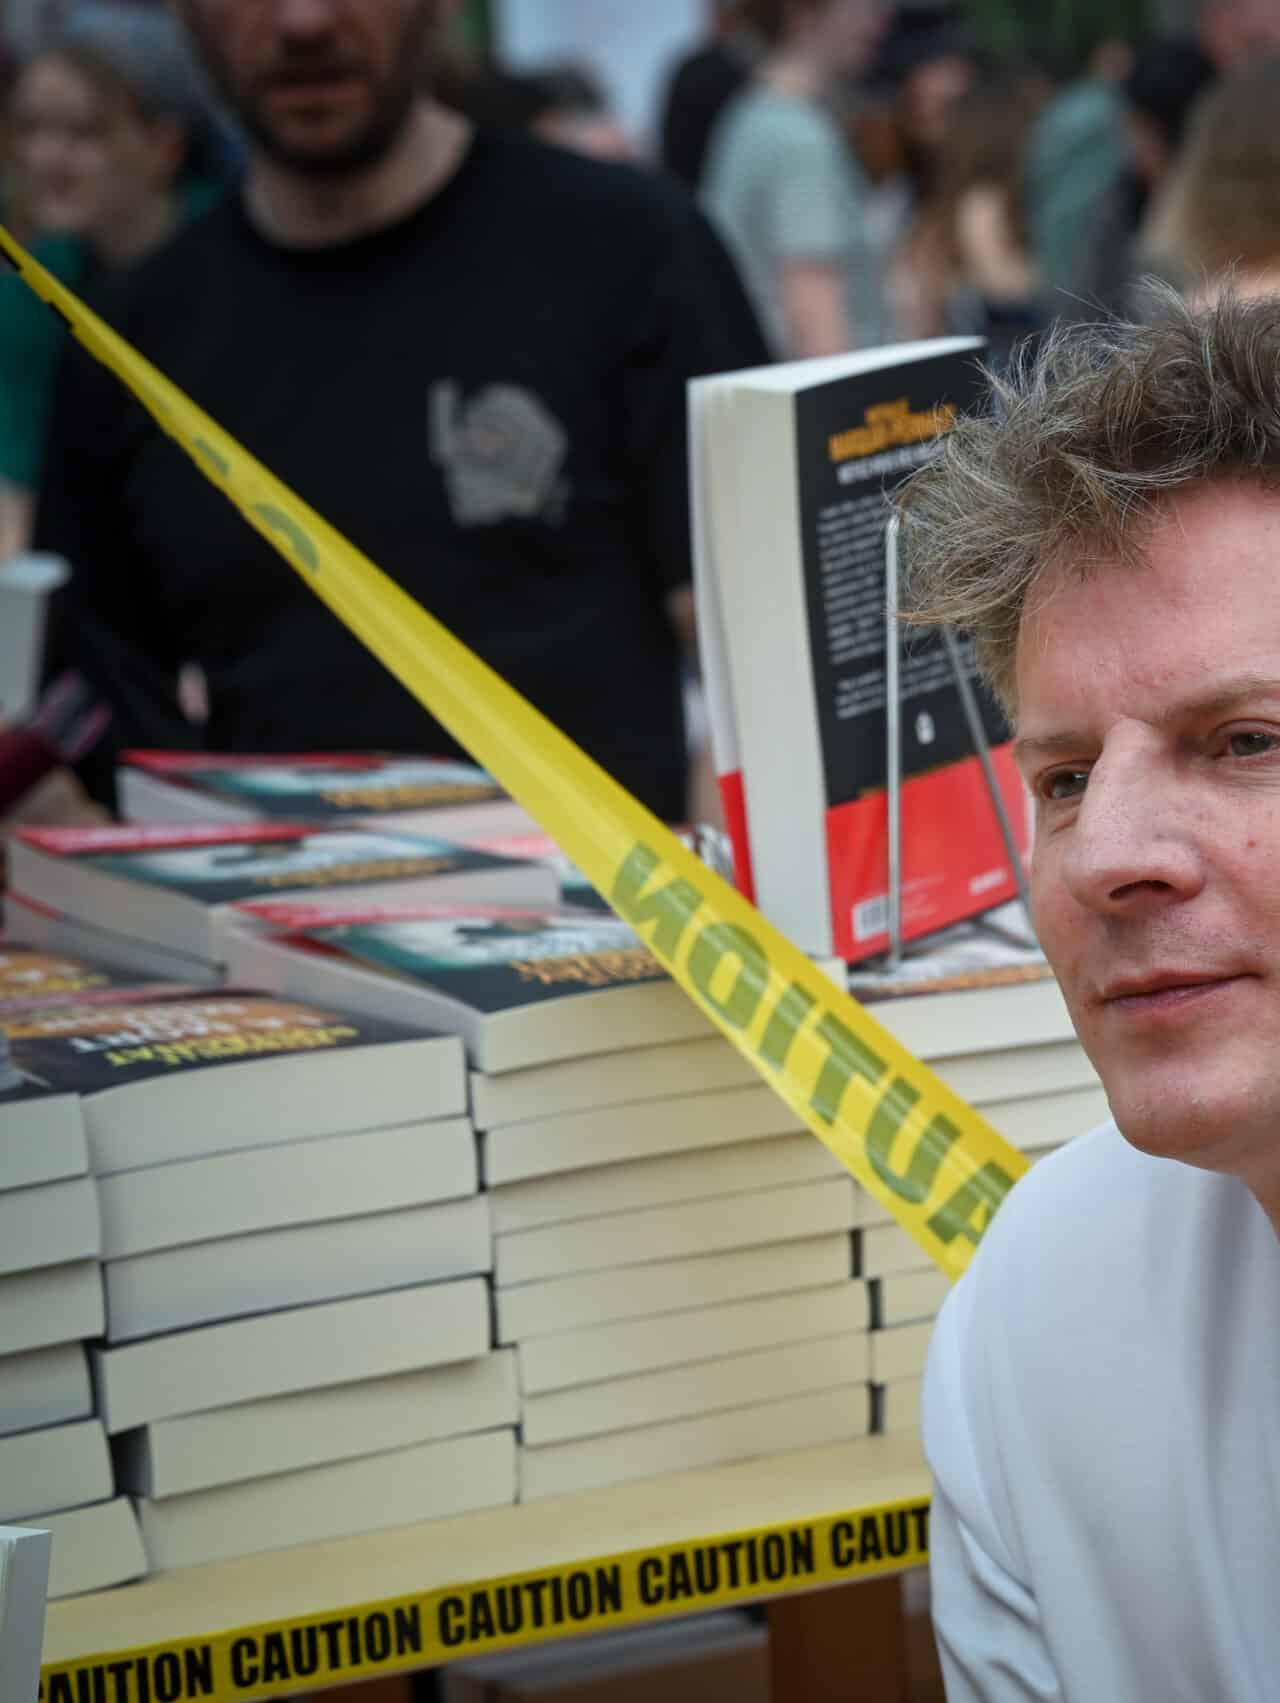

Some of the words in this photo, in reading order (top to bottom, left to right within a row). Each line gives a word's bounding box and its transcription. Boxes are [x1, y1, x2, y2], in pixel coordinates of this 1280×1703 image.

[39, 1645, 213, 1703] AUTION
[230, 1603, 422, 1688] CAUTION
[437, 1564, 622, 1646] CAUTION
[638, 1526, 816, 1606] CAUTION
[830, 1506, 930, 1568] CAUT
